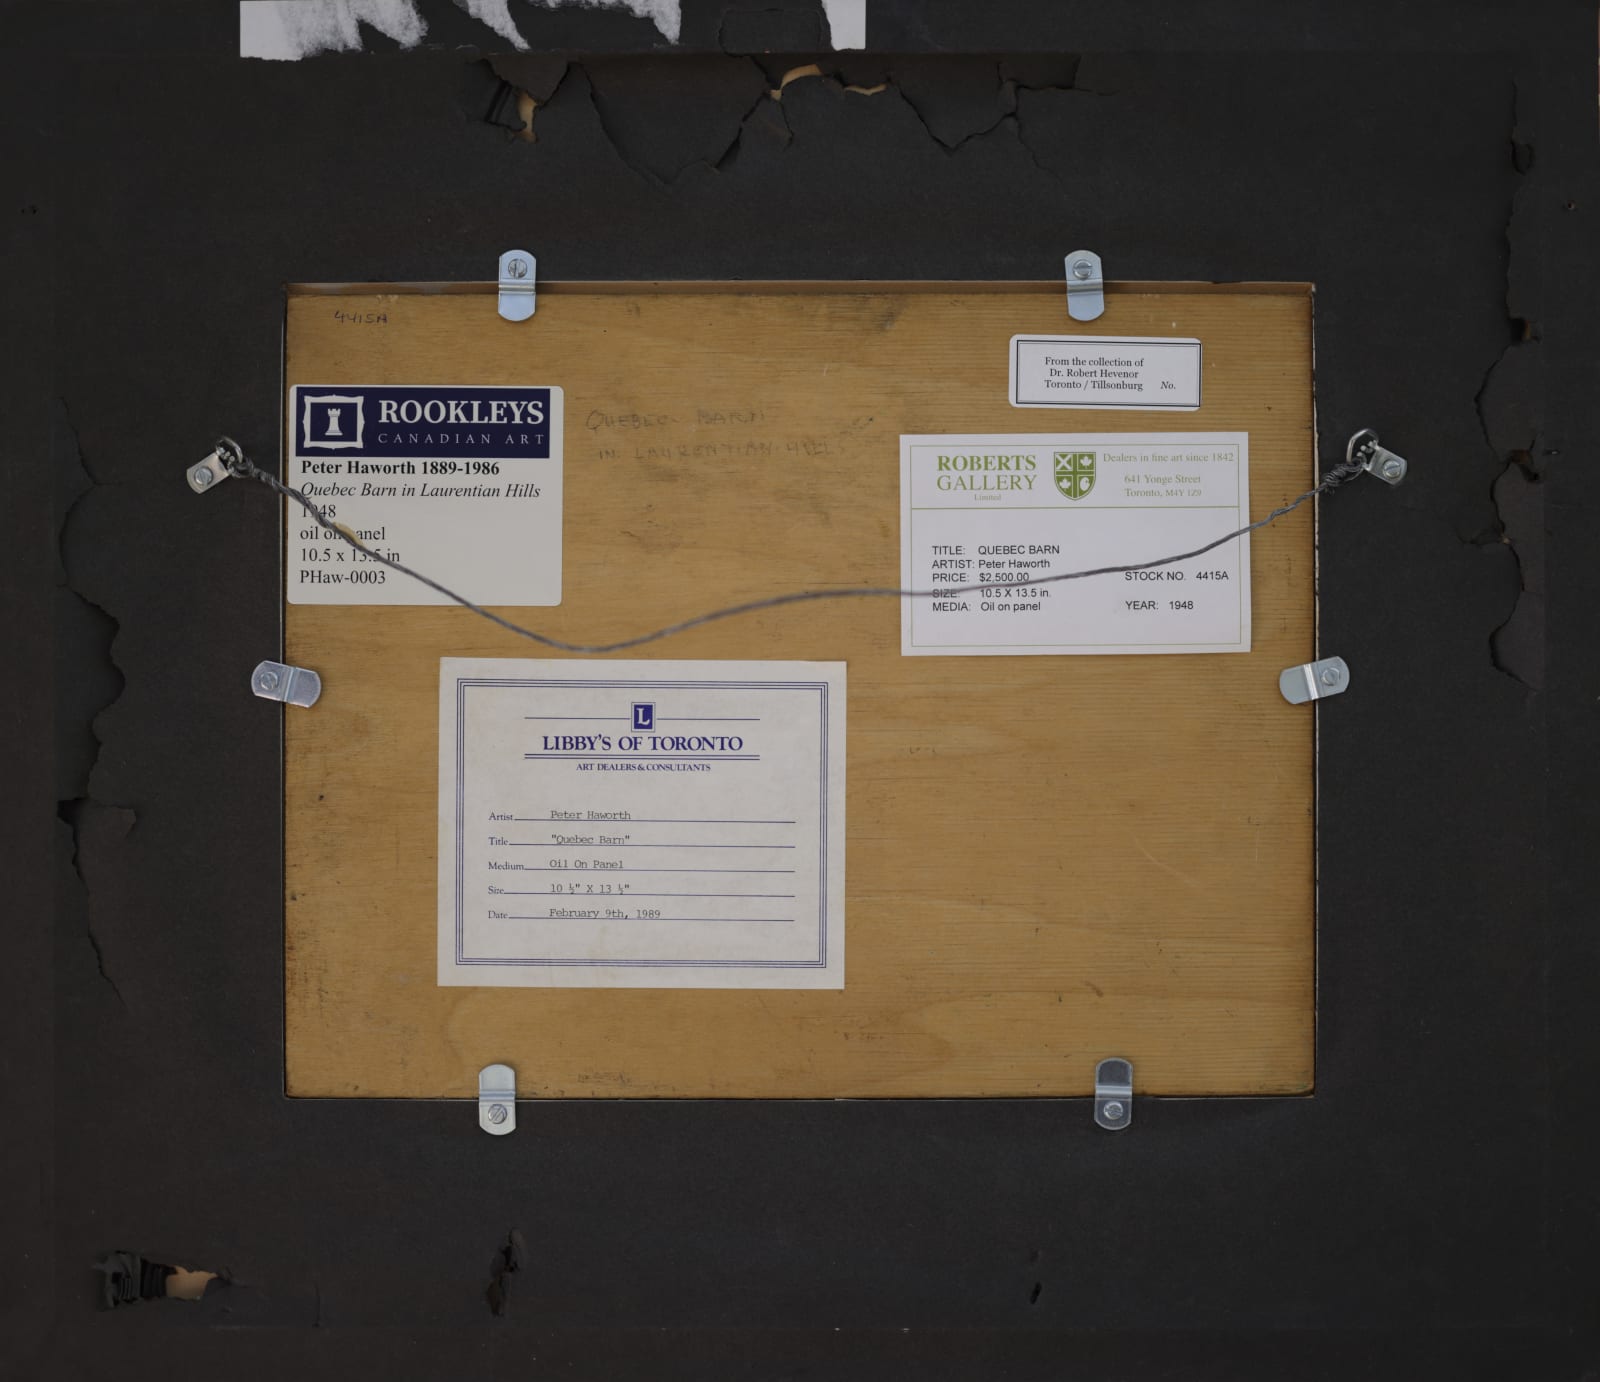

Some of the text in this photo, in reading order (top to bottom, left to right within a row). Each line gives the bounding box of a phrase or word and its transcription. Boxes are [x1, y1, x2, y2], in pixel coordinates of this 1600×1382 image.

[1045, 356, 1145, 367] From the collection of
[1049, 368, 1139, 379] Dr. Robert Hevenor
[1044, 380, 1082, 389] Toronto
[1091, 380, 1144, 392] Tillsonburg
[1160, 381, 1177, 390] No.
[378, 399, 545, 425] ROOKLEYS
[377, 432, 545, 445] CANADIAN ART
[937, 455, 1037, 471] ROBERTS
[1103, 452, 1234, 463] Dealers in fine art since 1842
[301, 460, 500, 476] Peter Haworth 1889-1986
[937, 474, 1038, 491] GALLERY
[1124, 473, 1201, 486] 641 Yonge Street
[301, 481, 541, 500] Quebec Barn in Laurentian Hills
[1124, 487, 1163, 498] Toronto,
[1165, 488, 1184, 497] M4Y
[974, 493, 1001, 501] Limited
[300, 526, 319, 540] oil
[348, 526, 386, 541] anel
[301, 548, 332, 562] 10.5
[336, 551, 345, 562] x
[386, 547, 400, 562] in
[932, 544, 1060, 556] TITLE: QUEBEC BARN
[932, 558, 1051, 569] ARTIST: Peter Haworth
[300, 569, 386, 584] PHaw-0003
[932, 572, 1030, 583] PRICE: $2,500.00
[1125, 570, 1229, 581] STOCK NO. 4415A
[980, 587, 1002, 598] 10.5
[1004, 587, 1012, 598] X
[1015, 587, 1037, 598] 13.5
[932, 601, 1041, 614] MEDIA: Oil on panel
[1125, 600, 1194, 610] YEAR: 1948
[542, 734, 744, 751] LIBBY'S OF TORONTO
[576, 763, 594, 772] ART
[488, 810, 631, 822] Artist Peter Haworth
[488, 834, 630, 847] Title "Quebec Barn"
[488, 859, 624, 872] Medium Oil On Panel
[488, 886, 505, 896] Size
[550, 884, 563, 893] 10
[586, 884, 593, 894] X
[599, 884, 612, 894] 13
[488, 908, 661, 920] Date February 9th, 1989
